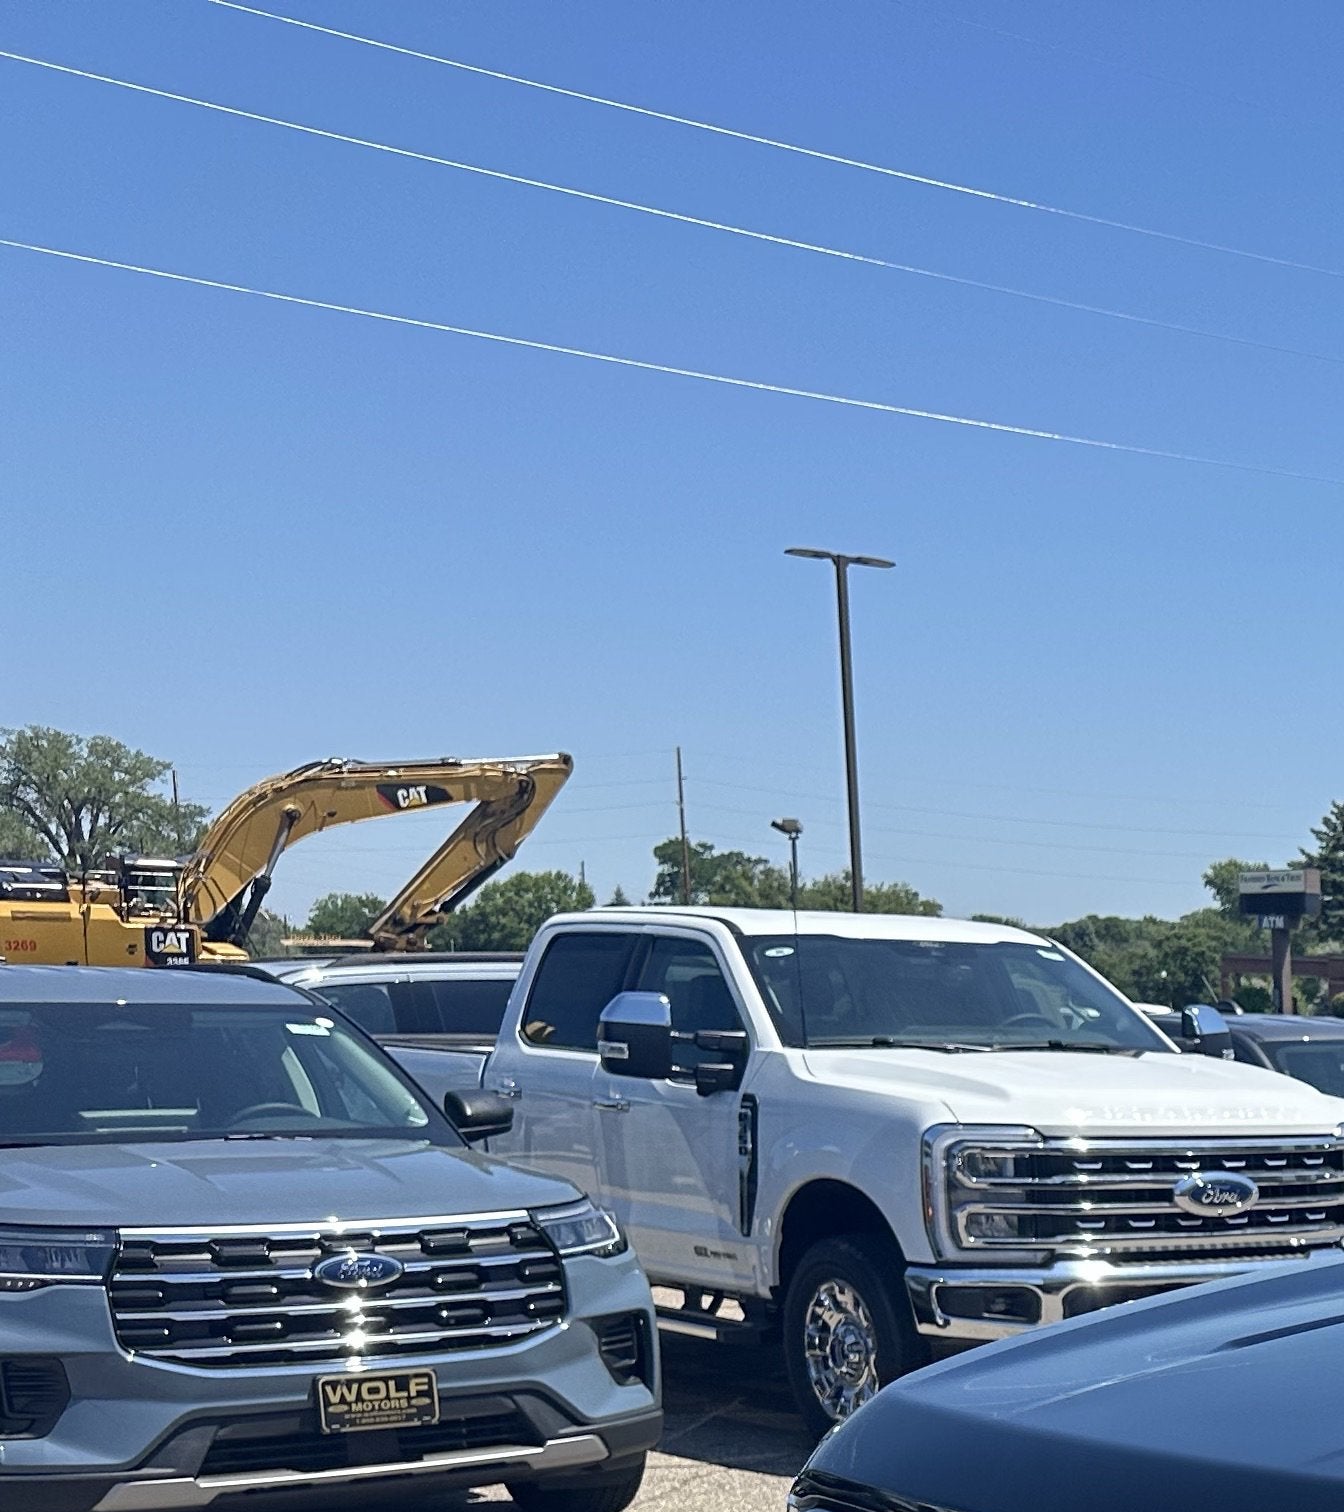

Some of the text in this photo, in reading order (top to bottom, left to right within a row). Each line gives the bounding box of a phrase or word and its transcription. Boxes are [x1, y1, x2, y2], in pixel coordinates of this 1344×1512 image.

[397, 785, 427, 808] CAT
[1263, 916, 1284, 929] ATM
[152, 931, 190, 954] CAT
[1201, 1184, 1240, 1204] Ford
[324, 1376, 429, 1404] WOLF
[351, 1398, 409, 1413] MOTORS
